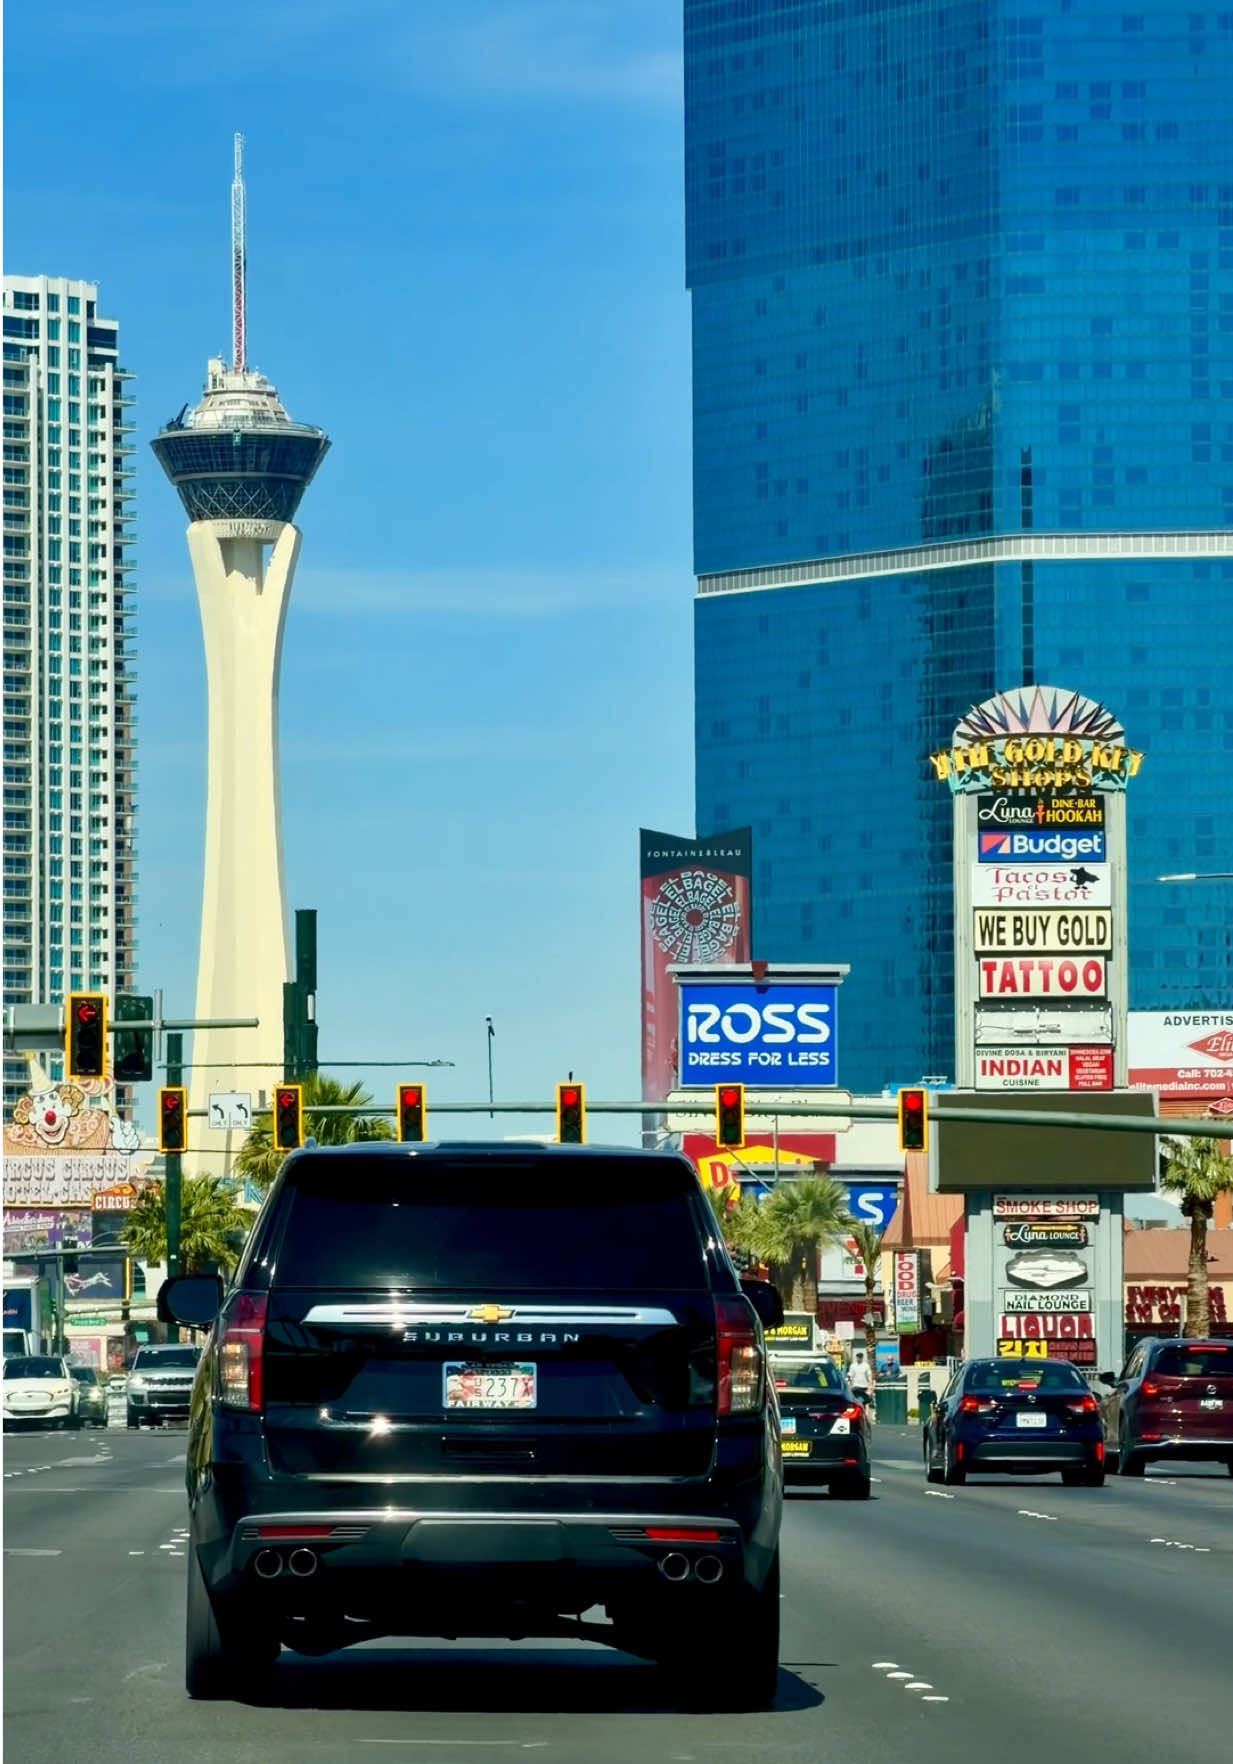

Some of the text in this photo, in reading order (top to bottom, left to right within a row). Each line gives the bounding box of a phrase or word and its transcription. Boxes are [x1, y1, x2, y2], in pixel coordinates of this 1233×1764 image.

[1004, 738, 1083, 764] GOLD
[1091, 742, 1145, 777] KEY
[992, 766, 1092, 788] SHOPS
[979, 797, 1036, 823] Luna
[1046, 810, 1102, 823] HOOKAH
[647, 849, 742, 858] FONTAINEBLEAU
[1013, 834, 1102, 859] Budget
[985, 867, 1068, 884] Tacos
[665, 877, 726, 903] EL BAGEL
[992, 887, 1092, 903] Pastor
[686, 890, 716, 909] BAGEL
[979, 915, 1107, 946] WE BUY GOLD
[982, 960, 1103, 993] TATTOO
[688, 1003, 831, 1043] ROSS
[1163, 1016, 1233, 1026] ADVERTIS
[1207, 1033, 1233, 1052] Eli
[688, 1052, 830, 1066] DRESS FOR LESS
[981, 1059, 1062, 1076] INDIAN
[1003, 1079, 1040, 1087] CUISINE
[63, 1158, 129, 1182] CIRCUS
[996, 1200, 1098, 1214] SMOKE SHOP
[1010, 1224, 1049, 1242] Luna
[1007, 1301, 1087, 1310] NAIL LOUNGE
[777, 1326, 808, 1336] MORGAN
[1002, 1314, 1093, 1338] LIQUOR
[403, 1331, 579, 1343] SUBURBAN
[999, 1340, 1048, 1358] 김치
[486, 1377, 519, 1398] 237
